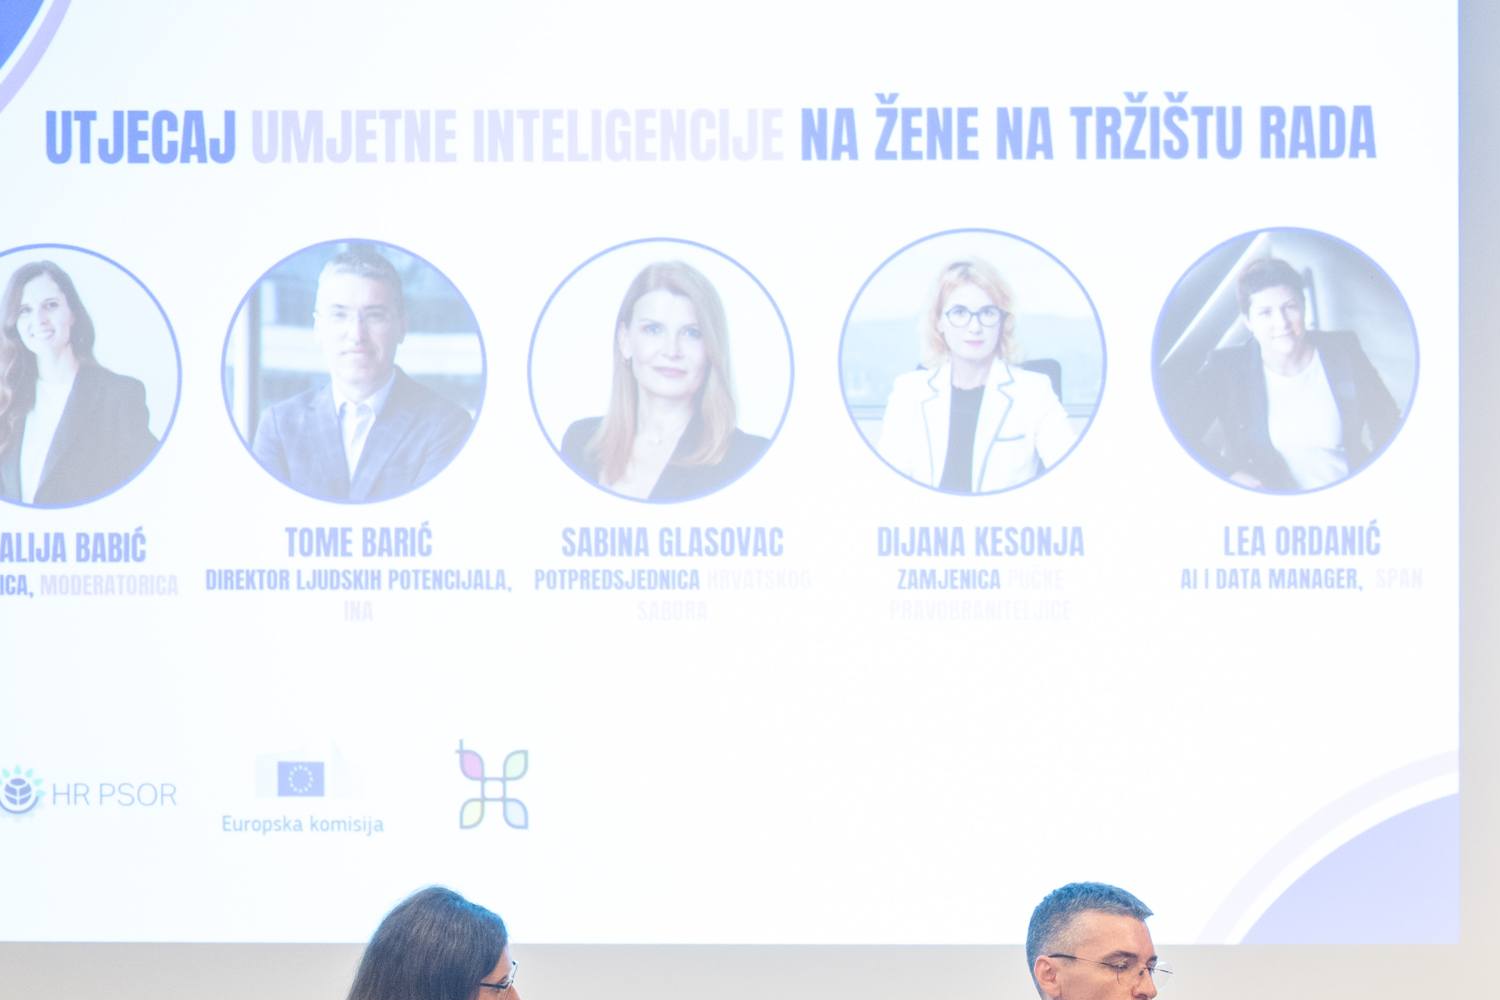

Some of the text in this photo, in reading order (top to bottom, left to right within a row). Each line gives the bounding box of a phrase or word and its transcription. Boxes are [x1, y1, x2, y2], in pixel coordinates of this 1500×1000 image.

[46, 91, 1377, 164] UTJECAJ UMJETNE INTELIGENCIJE NA ŽENE NA TRŽIŠTU RADA
[75, 526, 147, 563] BABIĆ
[285, 521, 433, 557] TOME BARIĆ
[562, 526, 784, 558] SABINA GLASOVAC
[877, 526, 1085, 557] DIJANA KESONJA
[1223, 519, 1381, 556] LEA ORDANIĆ
[40, 574, 179, 596] MODERATORICA
[206, 568, 513, 592] DIREKTOR LJUDSKIH POTENCIJALA,
[534, 569, 700, 590] POTPREDSJEDNICA
[897, 569, 1001, 590] ZAMJENICA
[1181, 568, 1198, 589] AI
[1204, 568, 1210, 589] I
[1216, 568, 1262, 589] DATA
[1268, 568, 1364, 592] MANAGER,
[344, 600, 374, 622] INA
[52, 783, 177, 806] HR PSOR
[222, 815, 384, 836] Europska komisija
